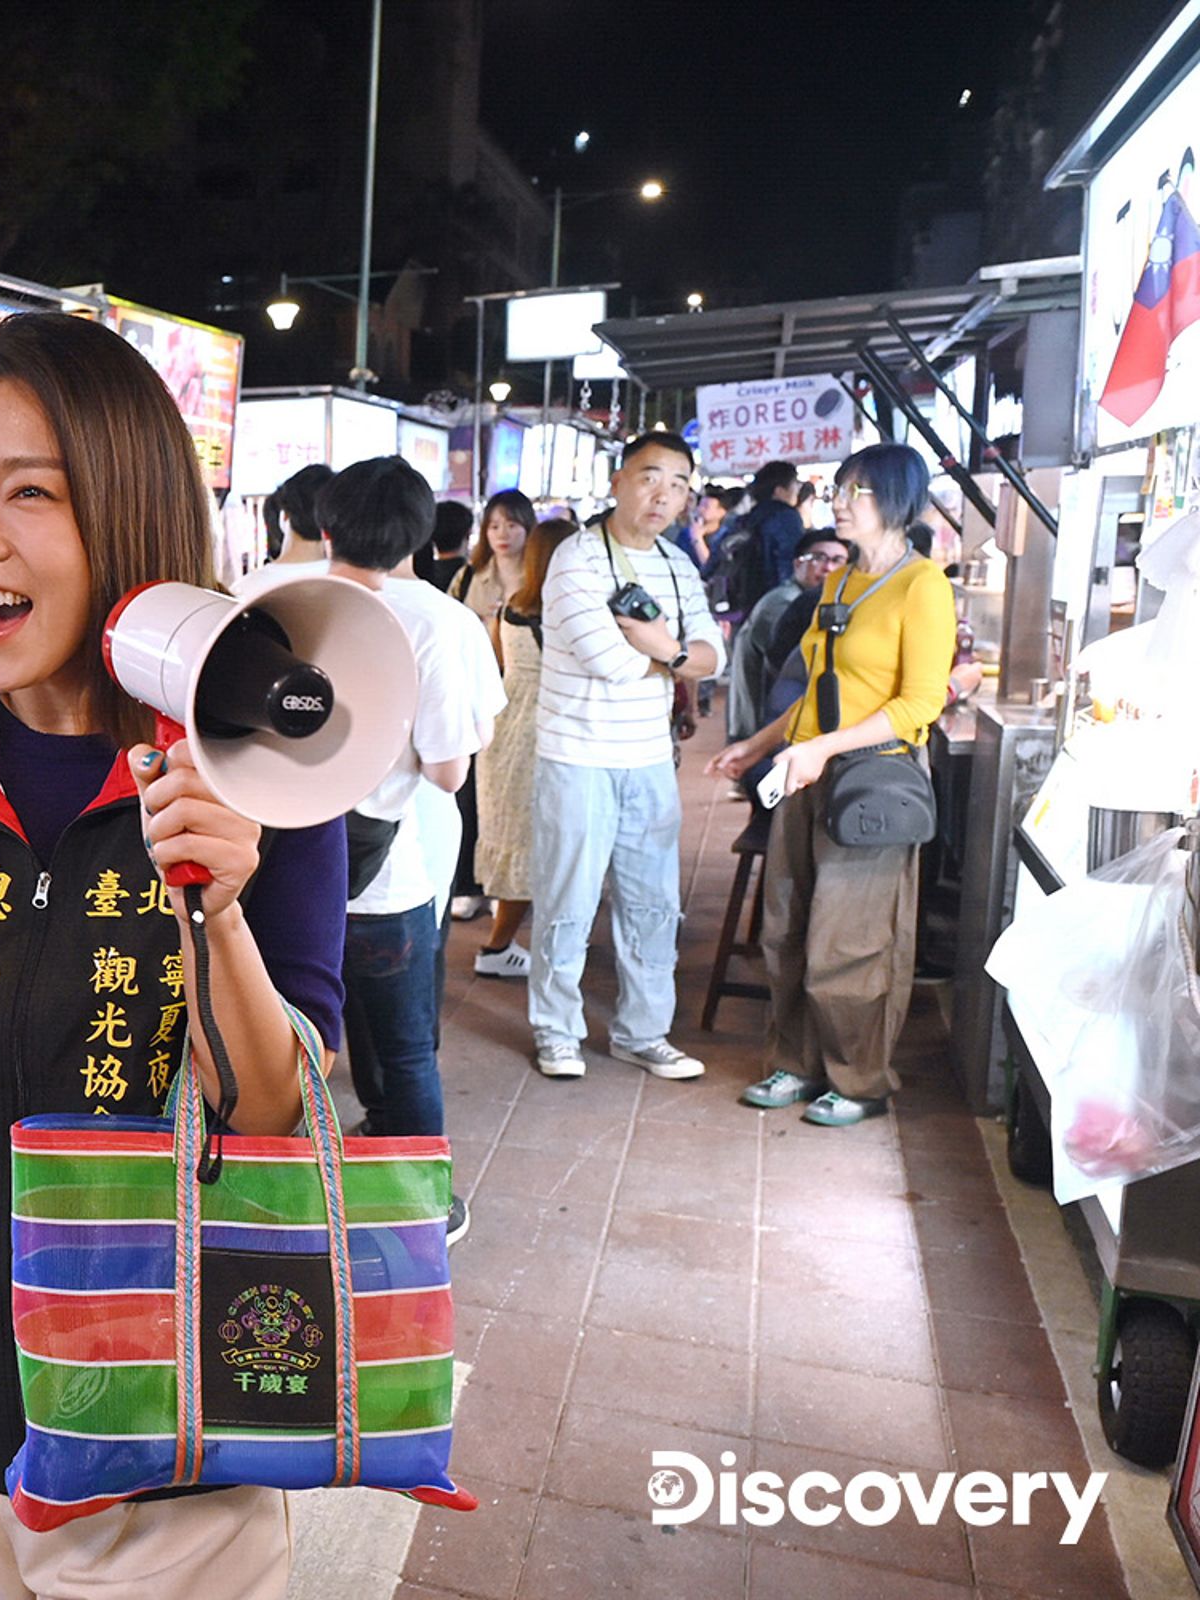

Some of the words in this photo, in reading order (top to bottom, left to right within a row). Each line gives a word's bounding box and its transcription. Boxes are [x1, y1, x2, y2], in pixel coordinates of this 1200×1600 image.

[737, 383, 781, 398] Crispy
[710, 426, 843, 462] 炸冰淇淋
[80, 946, 140, 1116] 觀光協
[146, 948, 188, 1118] 寧夏夜
[232, 1371, 308, 1394] 千歲宴
